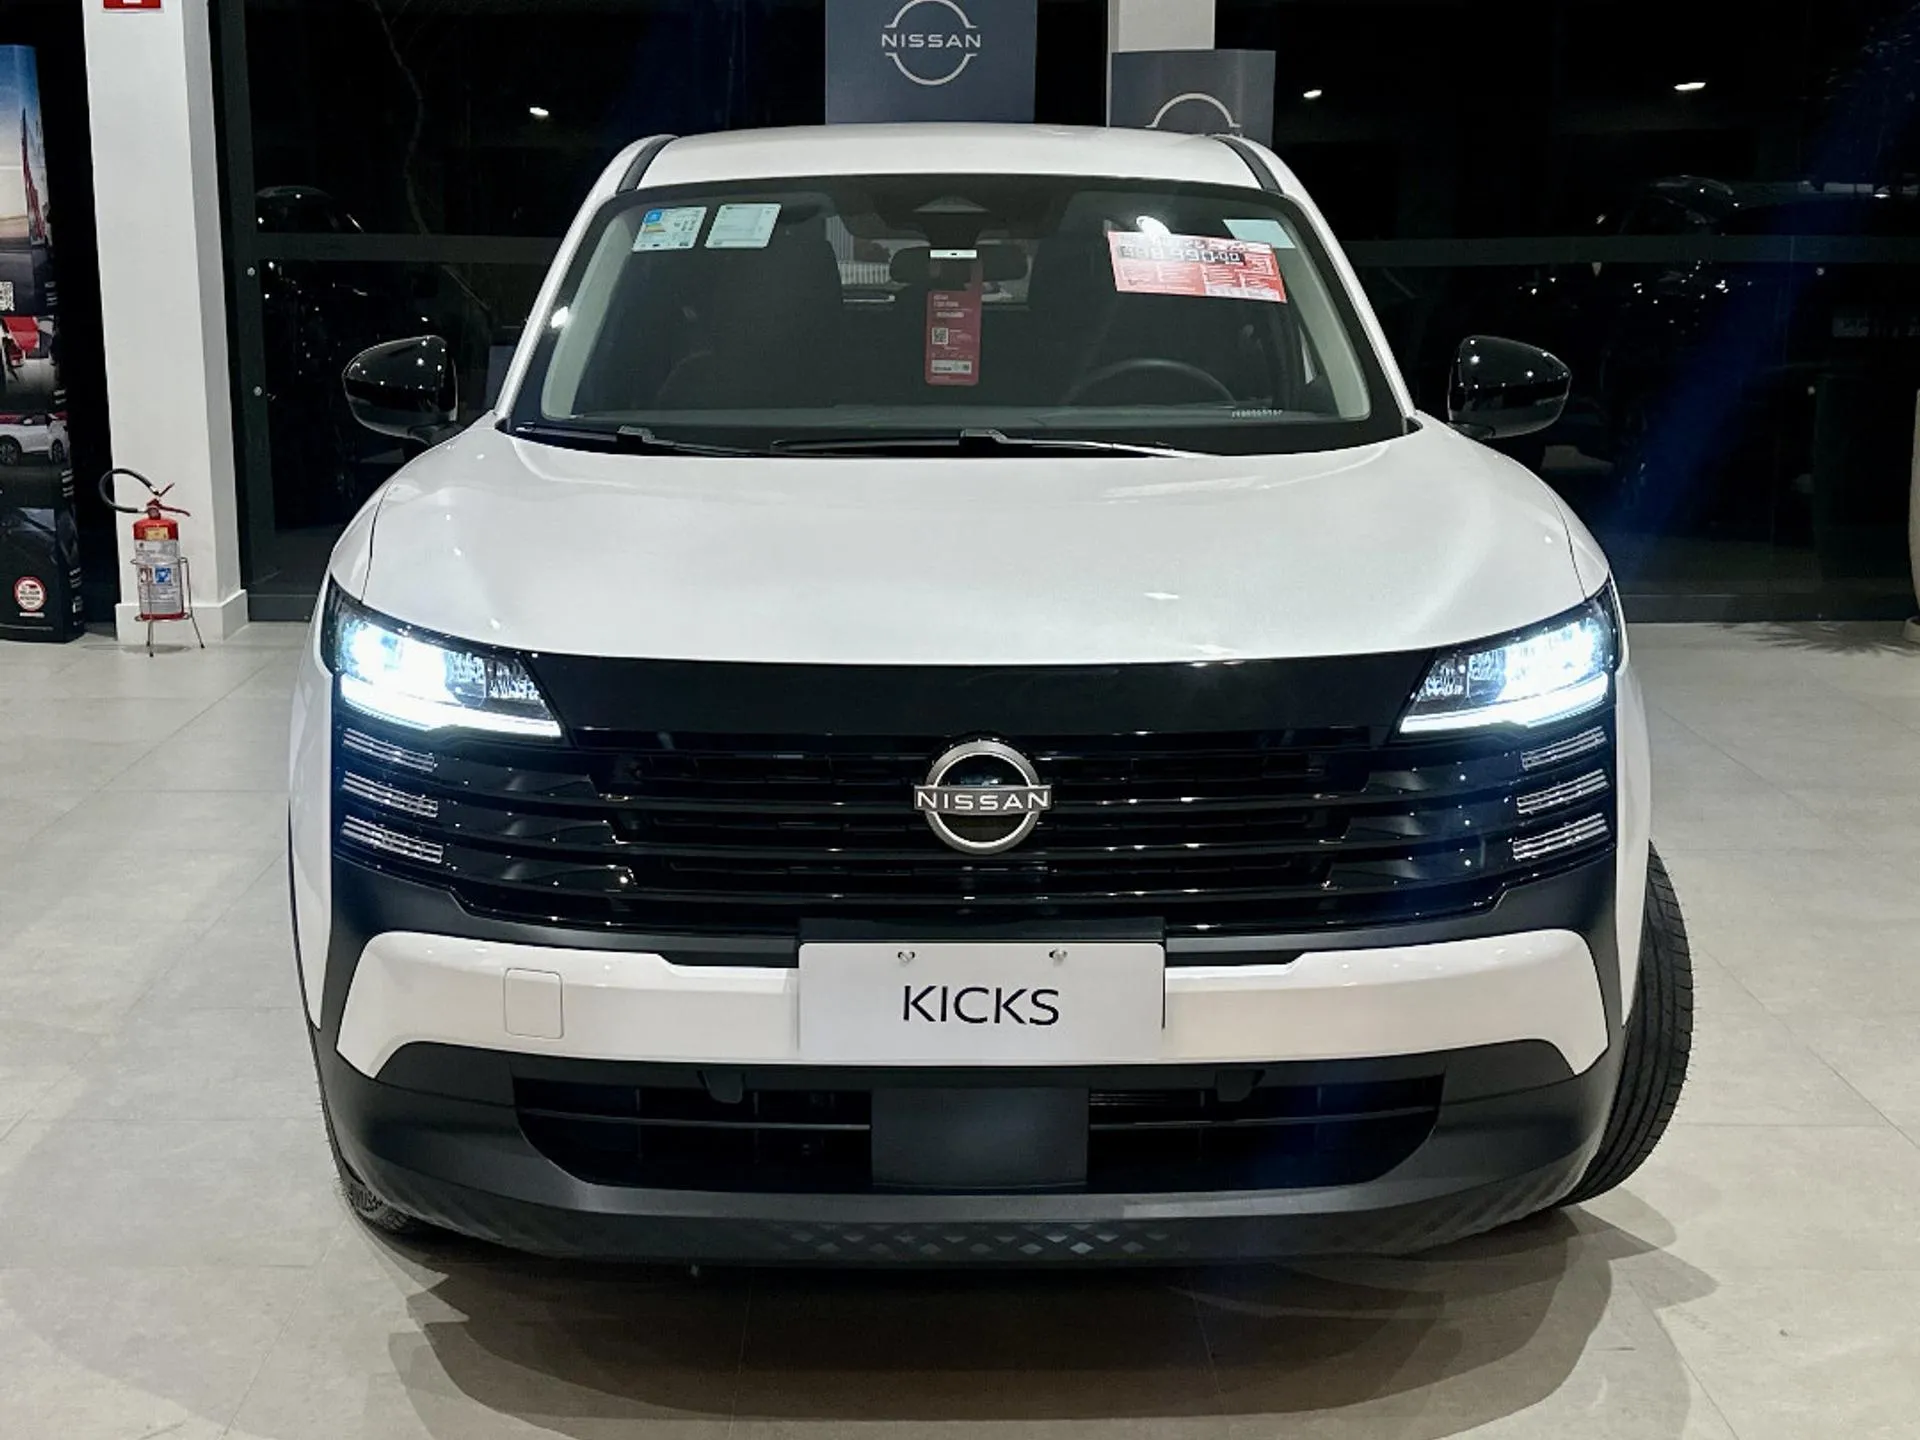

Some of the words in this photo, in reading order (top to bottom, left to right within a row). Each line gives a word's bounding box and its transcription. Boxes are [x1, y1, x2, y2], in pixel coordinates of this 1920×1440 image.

[881, 33, 982, 49] NISSAN
[915, 790, 1050, 811] NISSAN
[902, 984, 1060, 1026] KICKS
